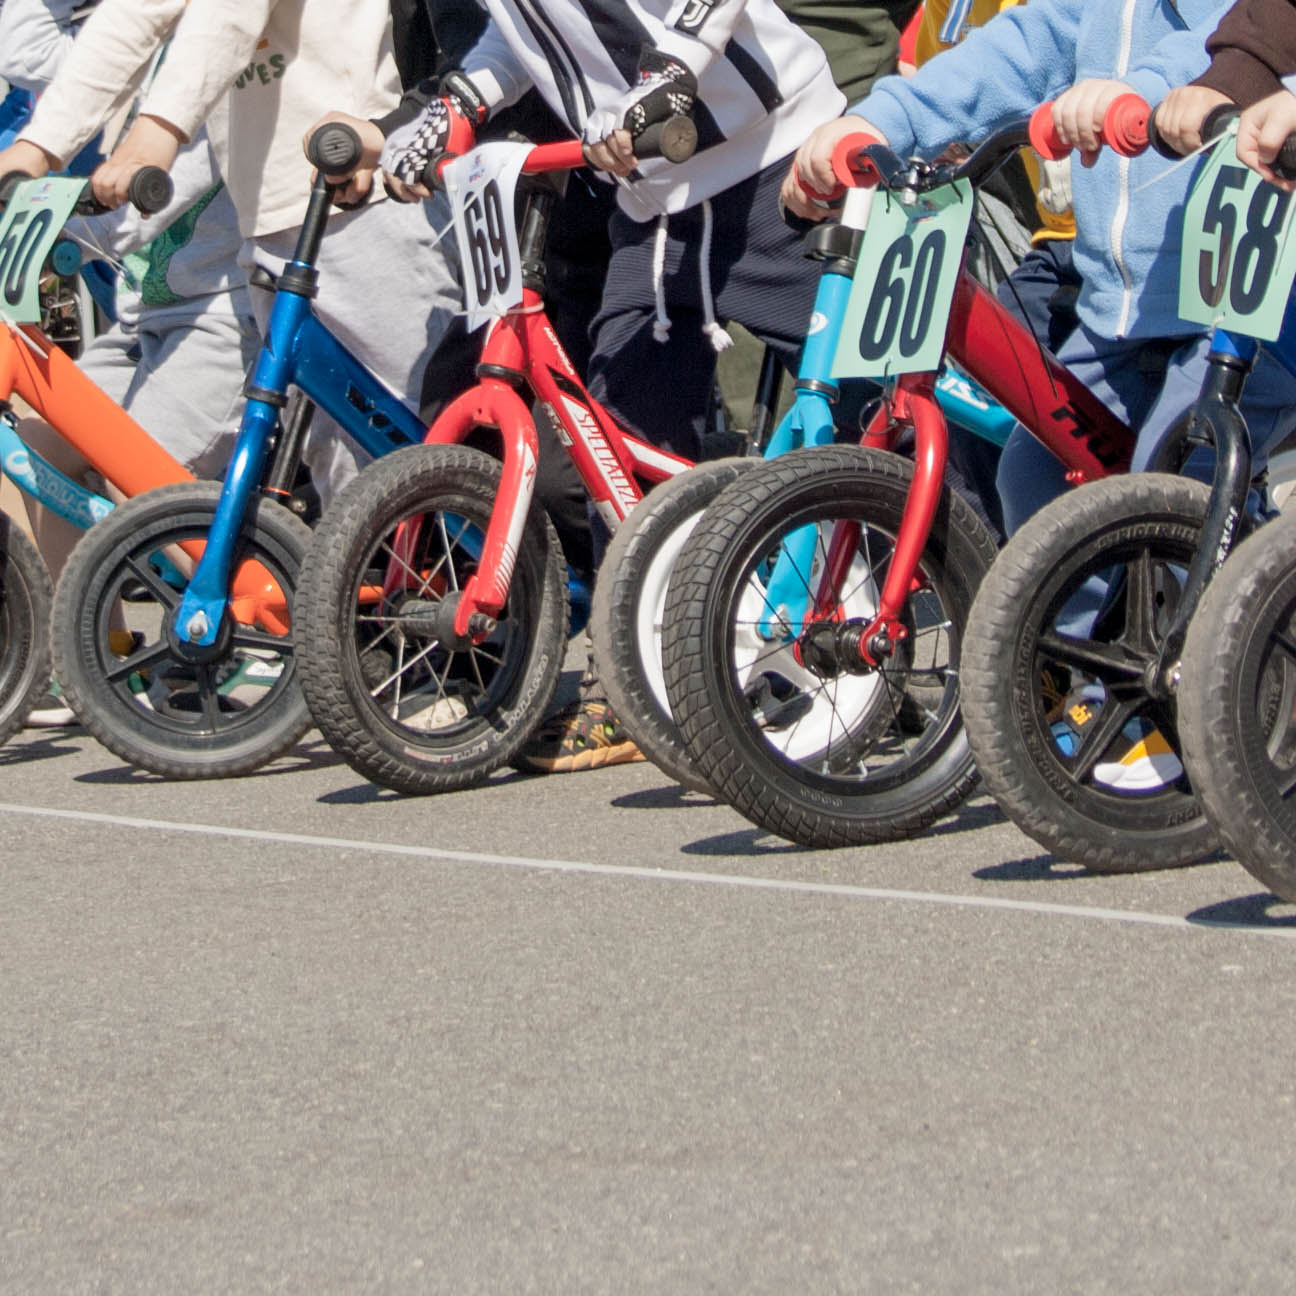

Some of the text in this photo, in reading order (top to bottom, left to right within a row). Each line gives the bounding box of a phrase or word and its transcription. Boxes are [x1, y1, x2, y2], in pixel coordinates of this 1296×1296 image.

[463, 178, 512, 307] 69
[858, 228, 947, 362] 60
[1198, 164, 1292, 316] 58
[577, 413, 642, 507] SPECIALIZ
